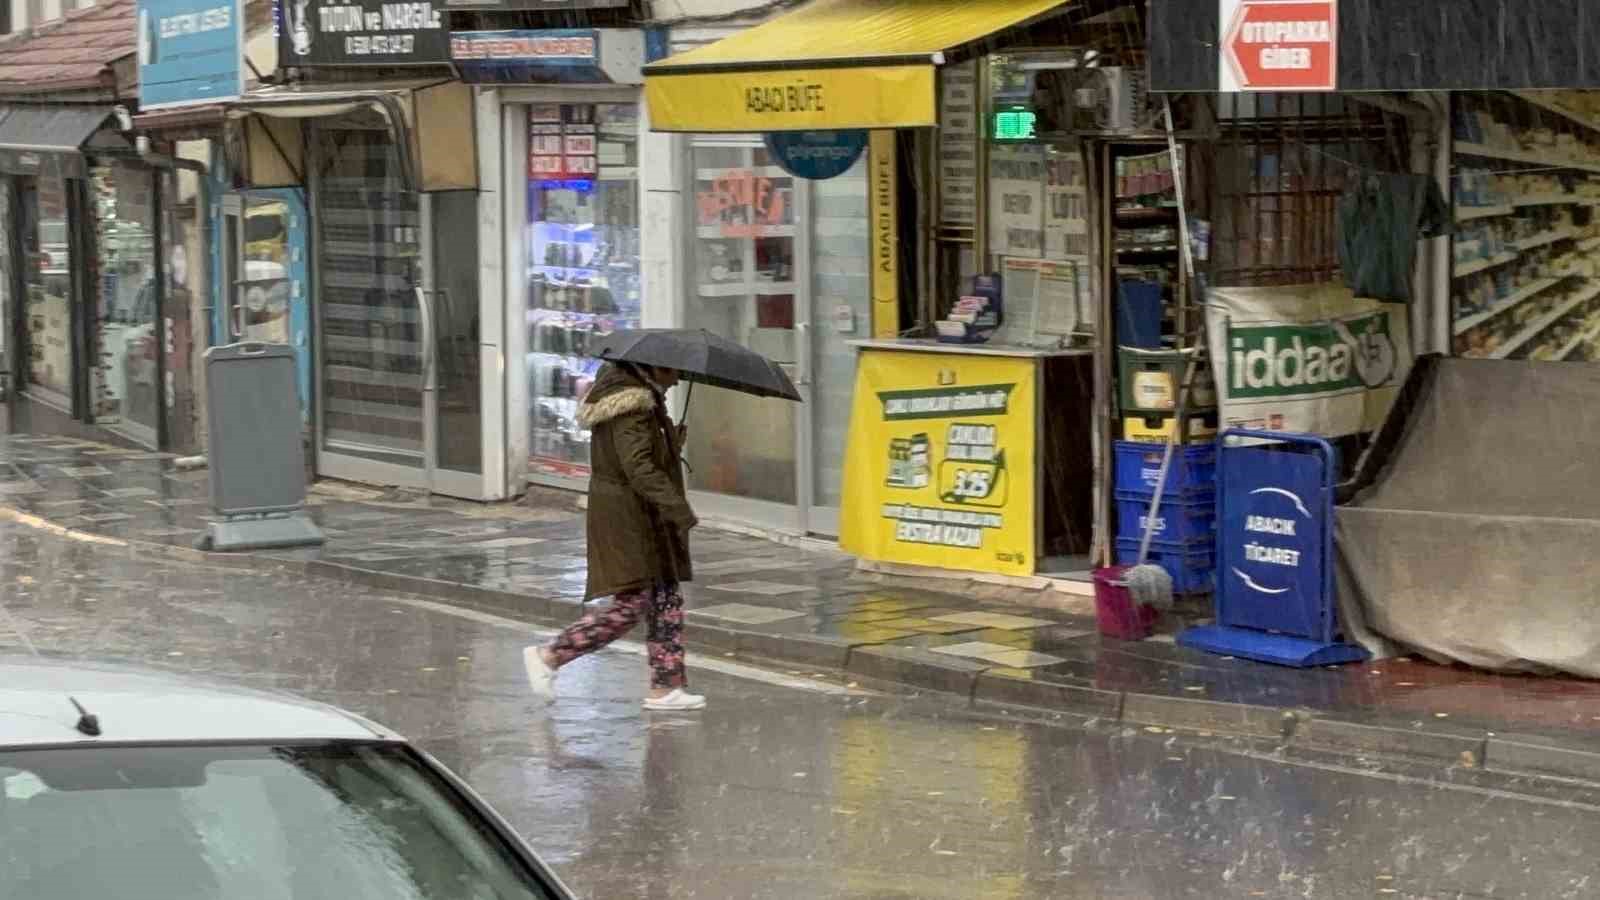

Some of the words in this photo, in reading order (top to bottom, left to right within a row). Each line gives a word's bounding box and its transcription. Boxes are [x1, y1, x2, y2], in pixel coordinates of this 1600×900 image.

[364, 12, 381, 31] ve
[1242, 20, 1330, 43] OTOPARKA
[786, 79, 825, 112] BÜFE
[1231, 335, 1350, 389] iddaa
[1243, 541, 1300, 567] TİCARET
